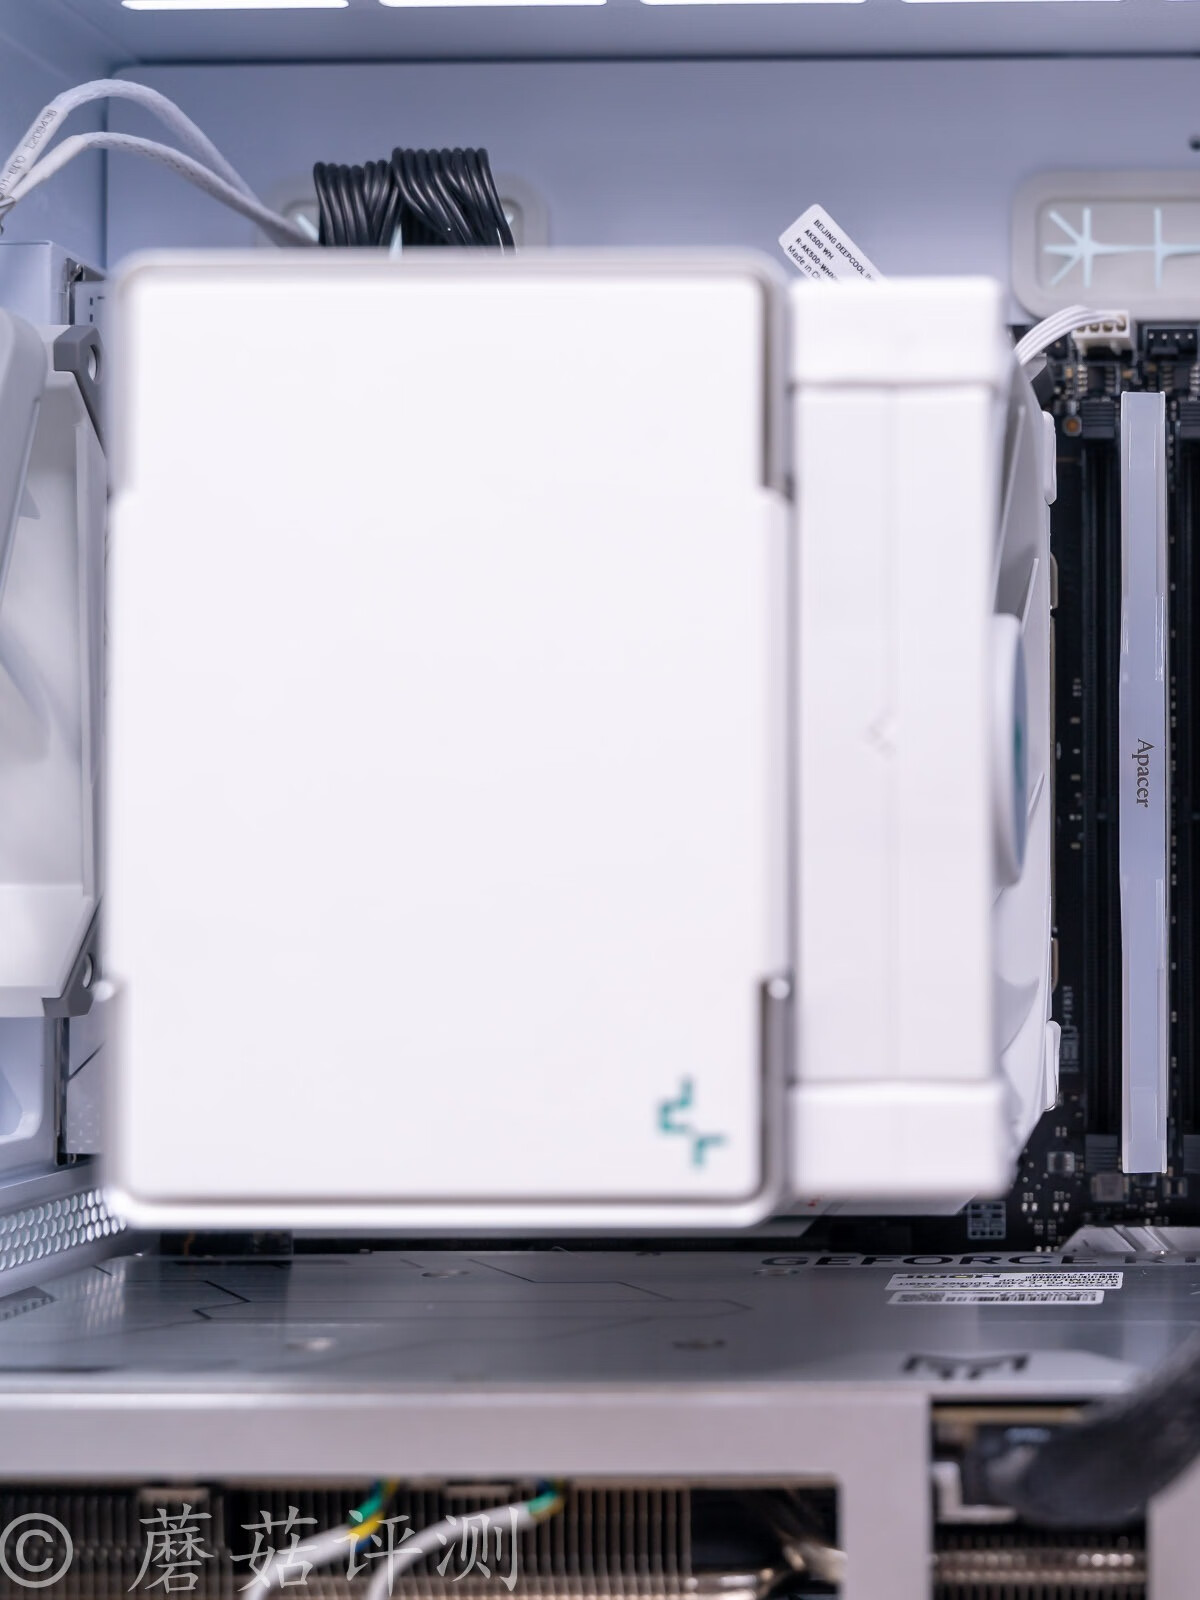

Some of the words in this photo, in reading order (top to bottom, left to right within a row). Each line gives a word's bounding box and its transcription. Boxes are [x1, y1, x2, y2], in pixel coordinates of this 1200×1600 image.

[787, 245, 805, 265] Made
[804, 264, 812, 272] in
[804, 229, 824, 249] AK500
[822, 247, 835, 261] WH
[813, 219, 837, 244] BEIJING
[836, 243, 865, 275] DEEPCOOL
[1131, 738, 1155, 808] Apacer
[761, 1255, 1098, 1266] GEFORCE
